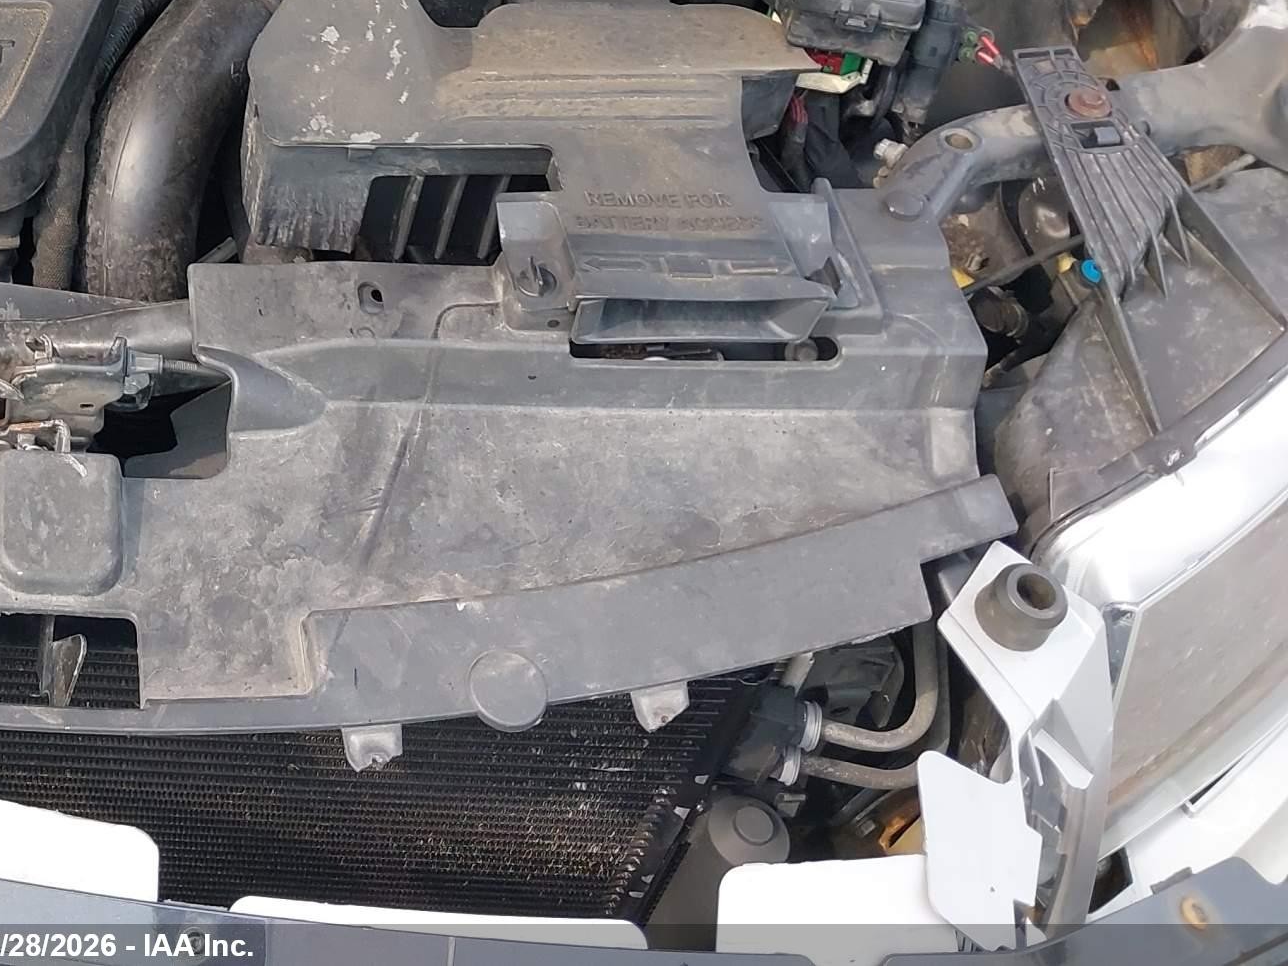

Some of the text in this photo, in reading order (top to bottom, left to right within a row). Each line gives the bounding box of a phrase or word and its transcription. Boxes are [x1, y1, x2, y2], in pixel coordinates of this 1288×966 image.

[584, 190, 734, 209] REMOVE FOR
[575, 215, 763, 232] BATTERY ACCESS
